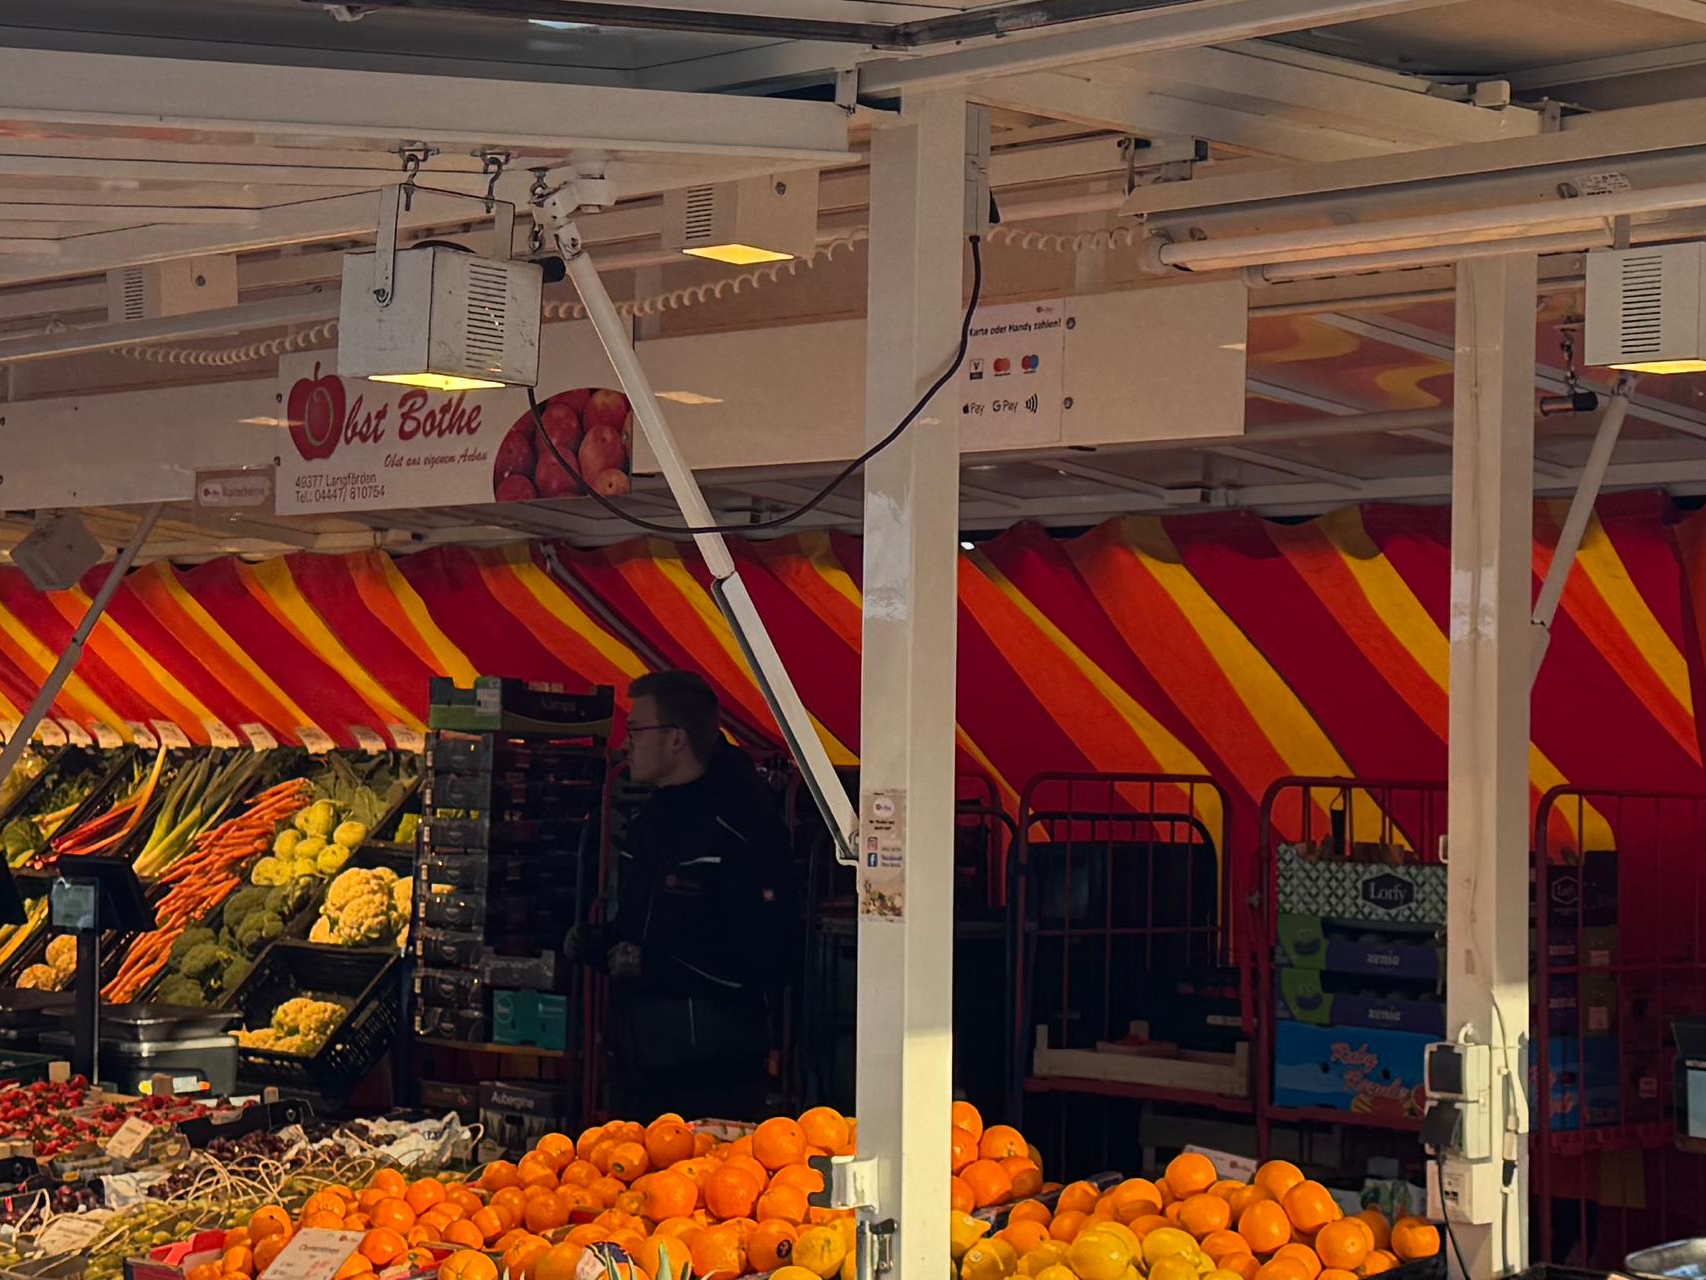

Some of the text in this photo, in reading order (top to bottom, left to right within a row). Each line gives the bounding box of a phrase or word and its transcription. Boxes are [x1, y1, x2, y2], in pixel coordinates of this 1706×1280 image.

[1009, 322, 1032, 333] Handy
[397, 388, 482, 442] Bothe
[296, 474, 324, 489] 49377
[1368, 880, 1409, 904] Lorfy
[1366, 950, 1400, 966] xenia
[1368, 1006, 1402, 1022] xenia
[491, 1090, 535, 1110] Aubergine
